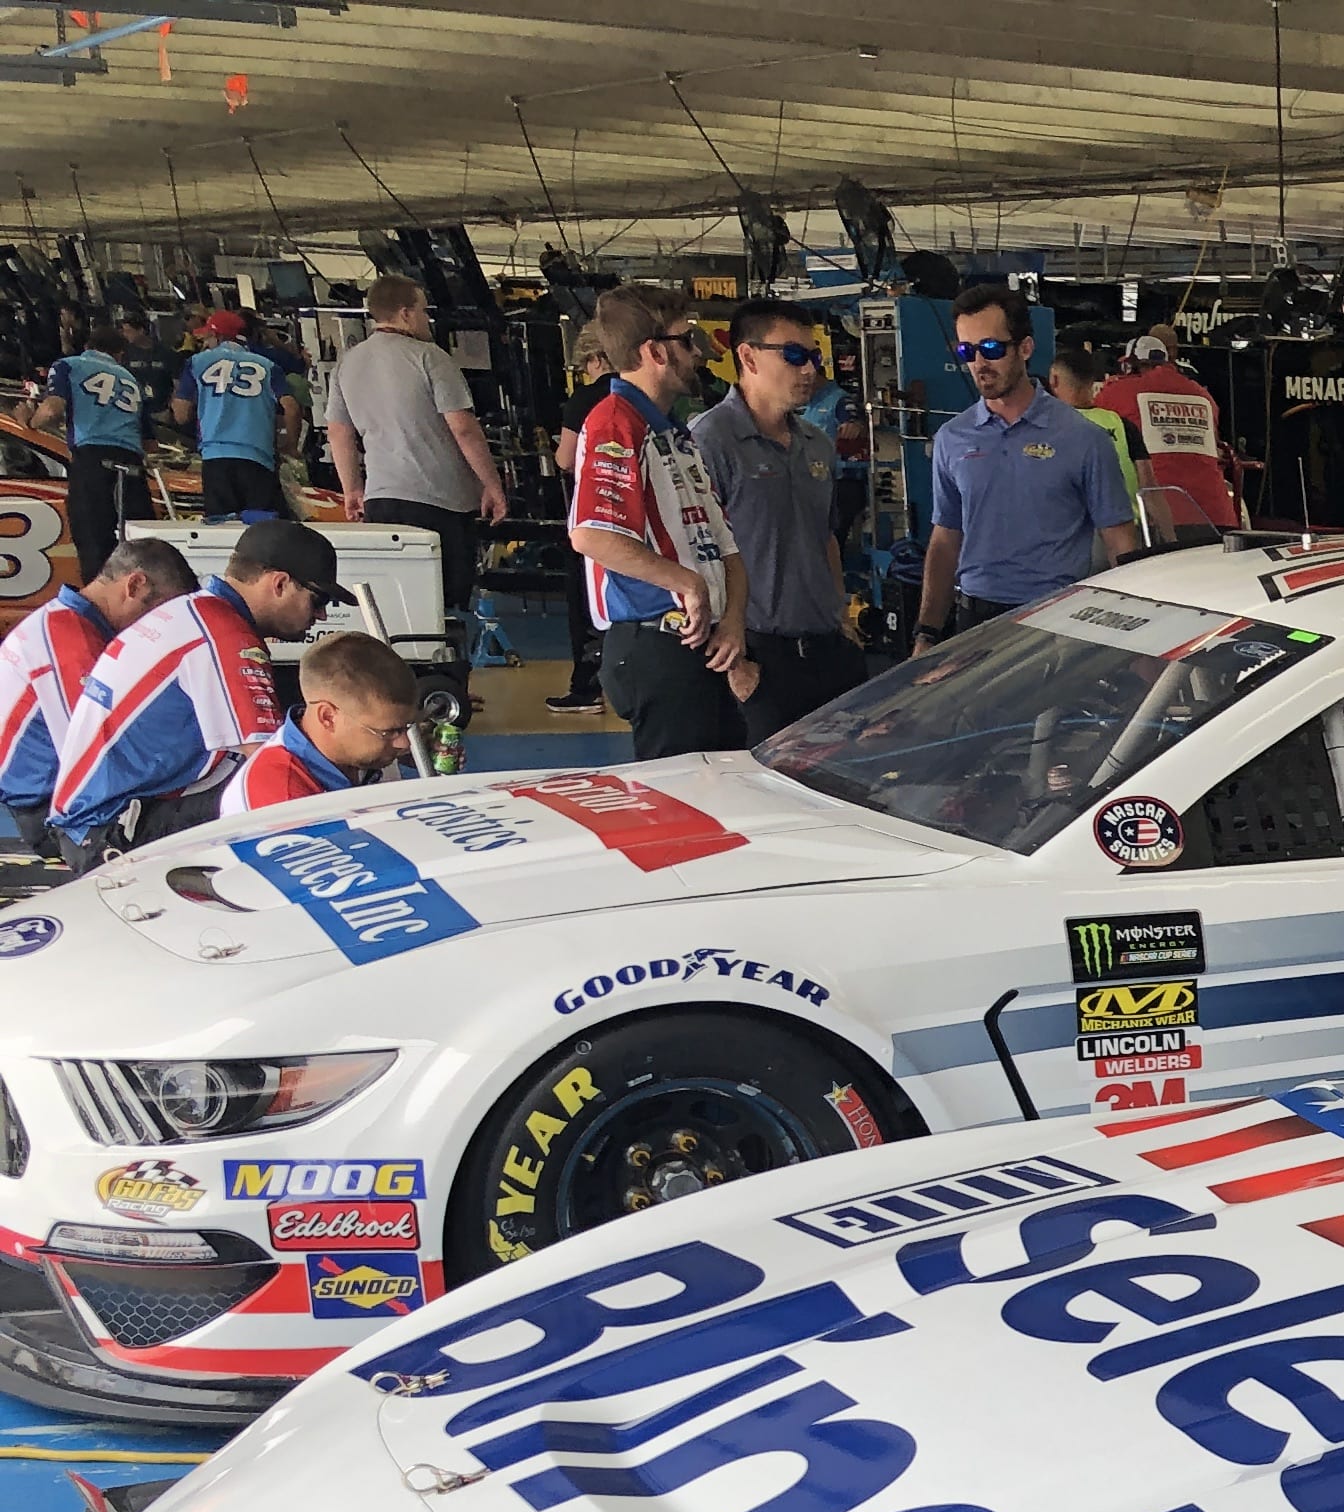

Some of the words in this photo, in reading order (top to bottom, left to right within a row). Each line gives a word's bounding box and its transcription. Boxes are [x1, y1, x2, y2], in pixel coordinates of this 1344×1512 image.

[202, 358, 267, 398] 43
[83, 371, 141, 413] 43
[1151, 404, 1207, 418] G-FORCE
[1103, 802, 1166, 826] NASCAR
[1109, 838, 1176, 862] SALUTES
[329, 881, 430, 943] Inc
[1115, 923, 1197, 943] MONSTER
[1128, 940, 1186, 950] ENERGY
[1081, 1016, 1154, 1032] MECHANIX
[1155, 1010, 1195, 1026] WEAR
[1082, 1034, 1181, 1058] LINCOLN
[1104, 1053, 1192, 1076] WELDERS
[495, 1066, 602, 1218] YEAR
[231, 1163, 418, 1197] MOOG
[273, 1209, 415, 1240] Edelbrock
[318, 1278, 413, 1296] SUNOCO
